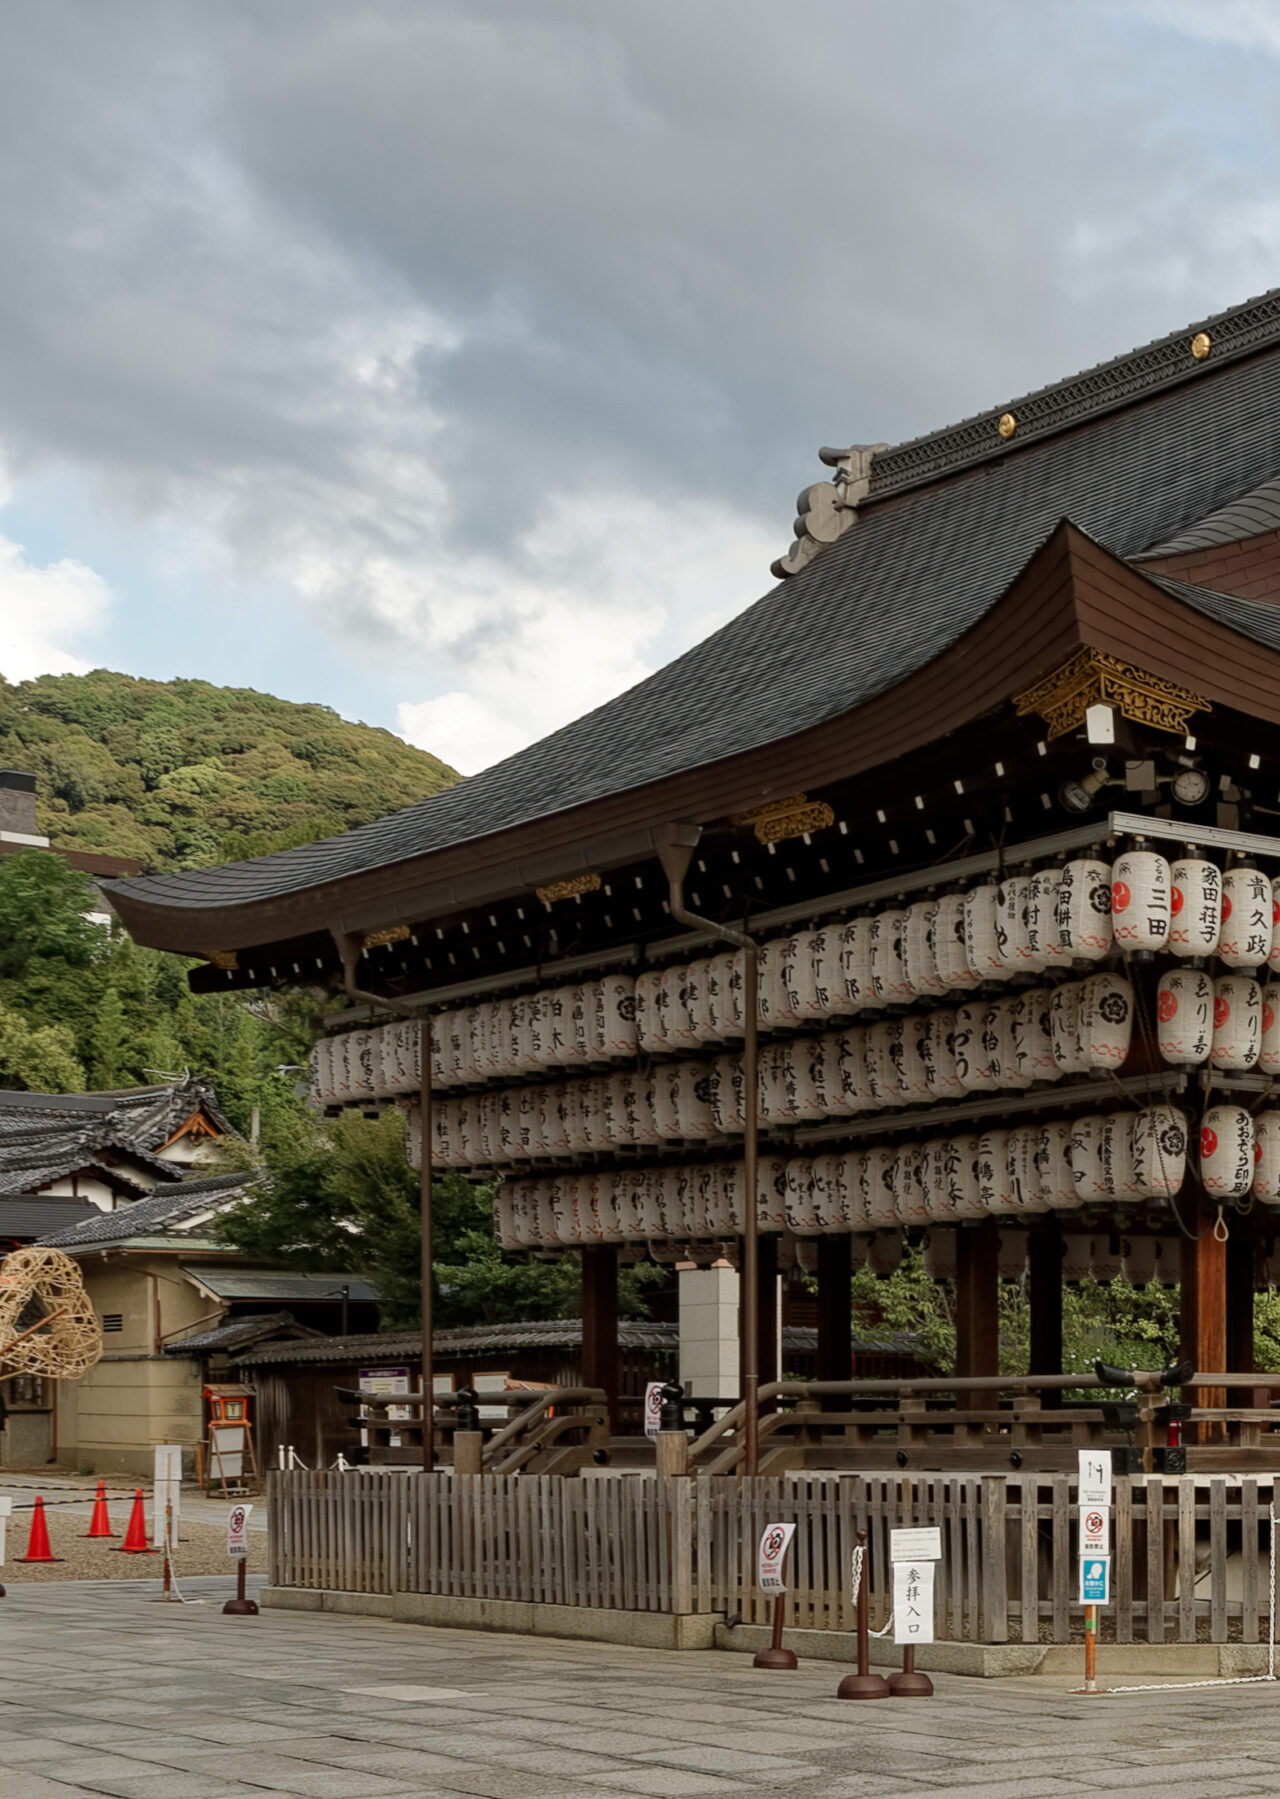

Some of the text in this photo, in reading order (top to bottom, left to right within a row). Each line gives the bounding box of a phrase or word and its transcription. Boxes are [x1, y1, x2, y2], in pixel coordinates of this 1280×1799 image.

[1200, 865, 1219, 944] 家田荘子
[1247, 875, 1268, 957] 貴久政
[1228, 1112, 1249, 1194] あおぞら印刷
[906, 1568, 921, 1634] 参拝入口
